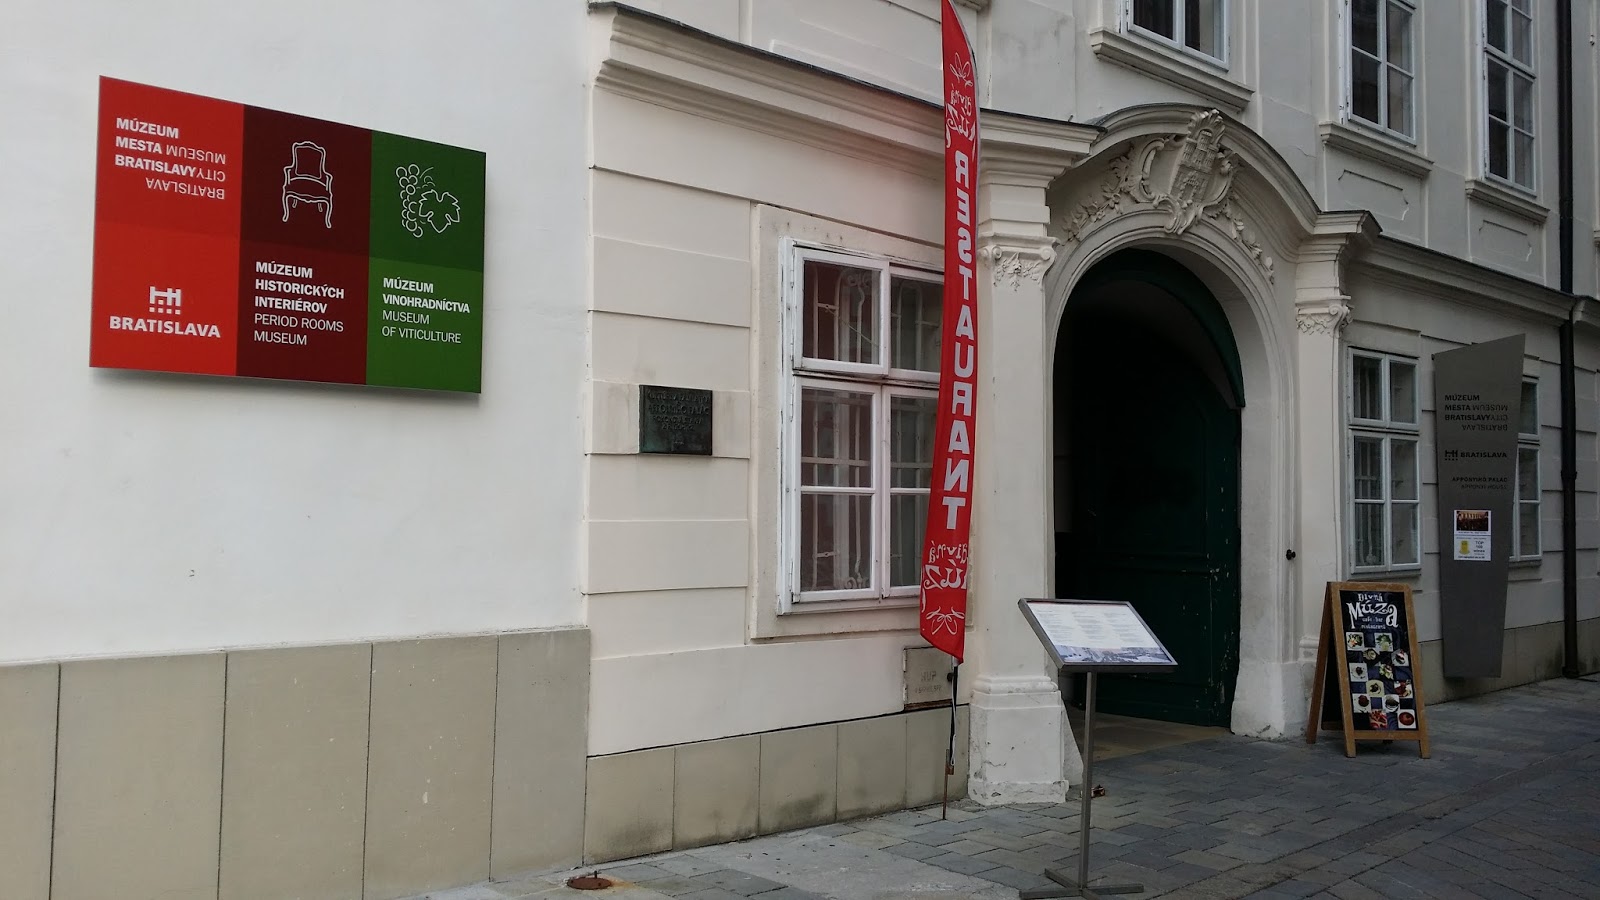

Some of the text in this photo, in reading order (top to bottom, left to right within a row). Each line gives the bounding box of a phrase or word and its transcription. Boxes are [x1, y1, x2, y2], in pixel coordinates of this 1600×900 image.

[116, 118, 178, 138] MÚZEUM
[116, 136, 162, 154] MESTA
[166, 144, 226, 164] MUSEUM
[115, 154, 196, 177] BRATISLAVY
[196, 170, 226, 182] CITY
[146, 178, 224, 199] BRATISLAVA
[256, 261, 313, 278] MÚZEUM
[255, 278, 345, 299] HISTORICKÝCH
[383, 276, 434, 294] MÚZEUM
[254, 296, 328, 314] INTERIÉROV
[382, 293, 471, 314] VINOHRADNÍCTVA
[109, 315, 221, 338] BRATISLAVA
[254, 313, 344, 332] PERIOD ROOMS
[382, 310, 430, 324] MUSEUM
[254, 330, 308, 346] MUSEUM
[382, 326, 462, 344] OF VITICULTURE
[1346, 600, 1399, 629] Múza
